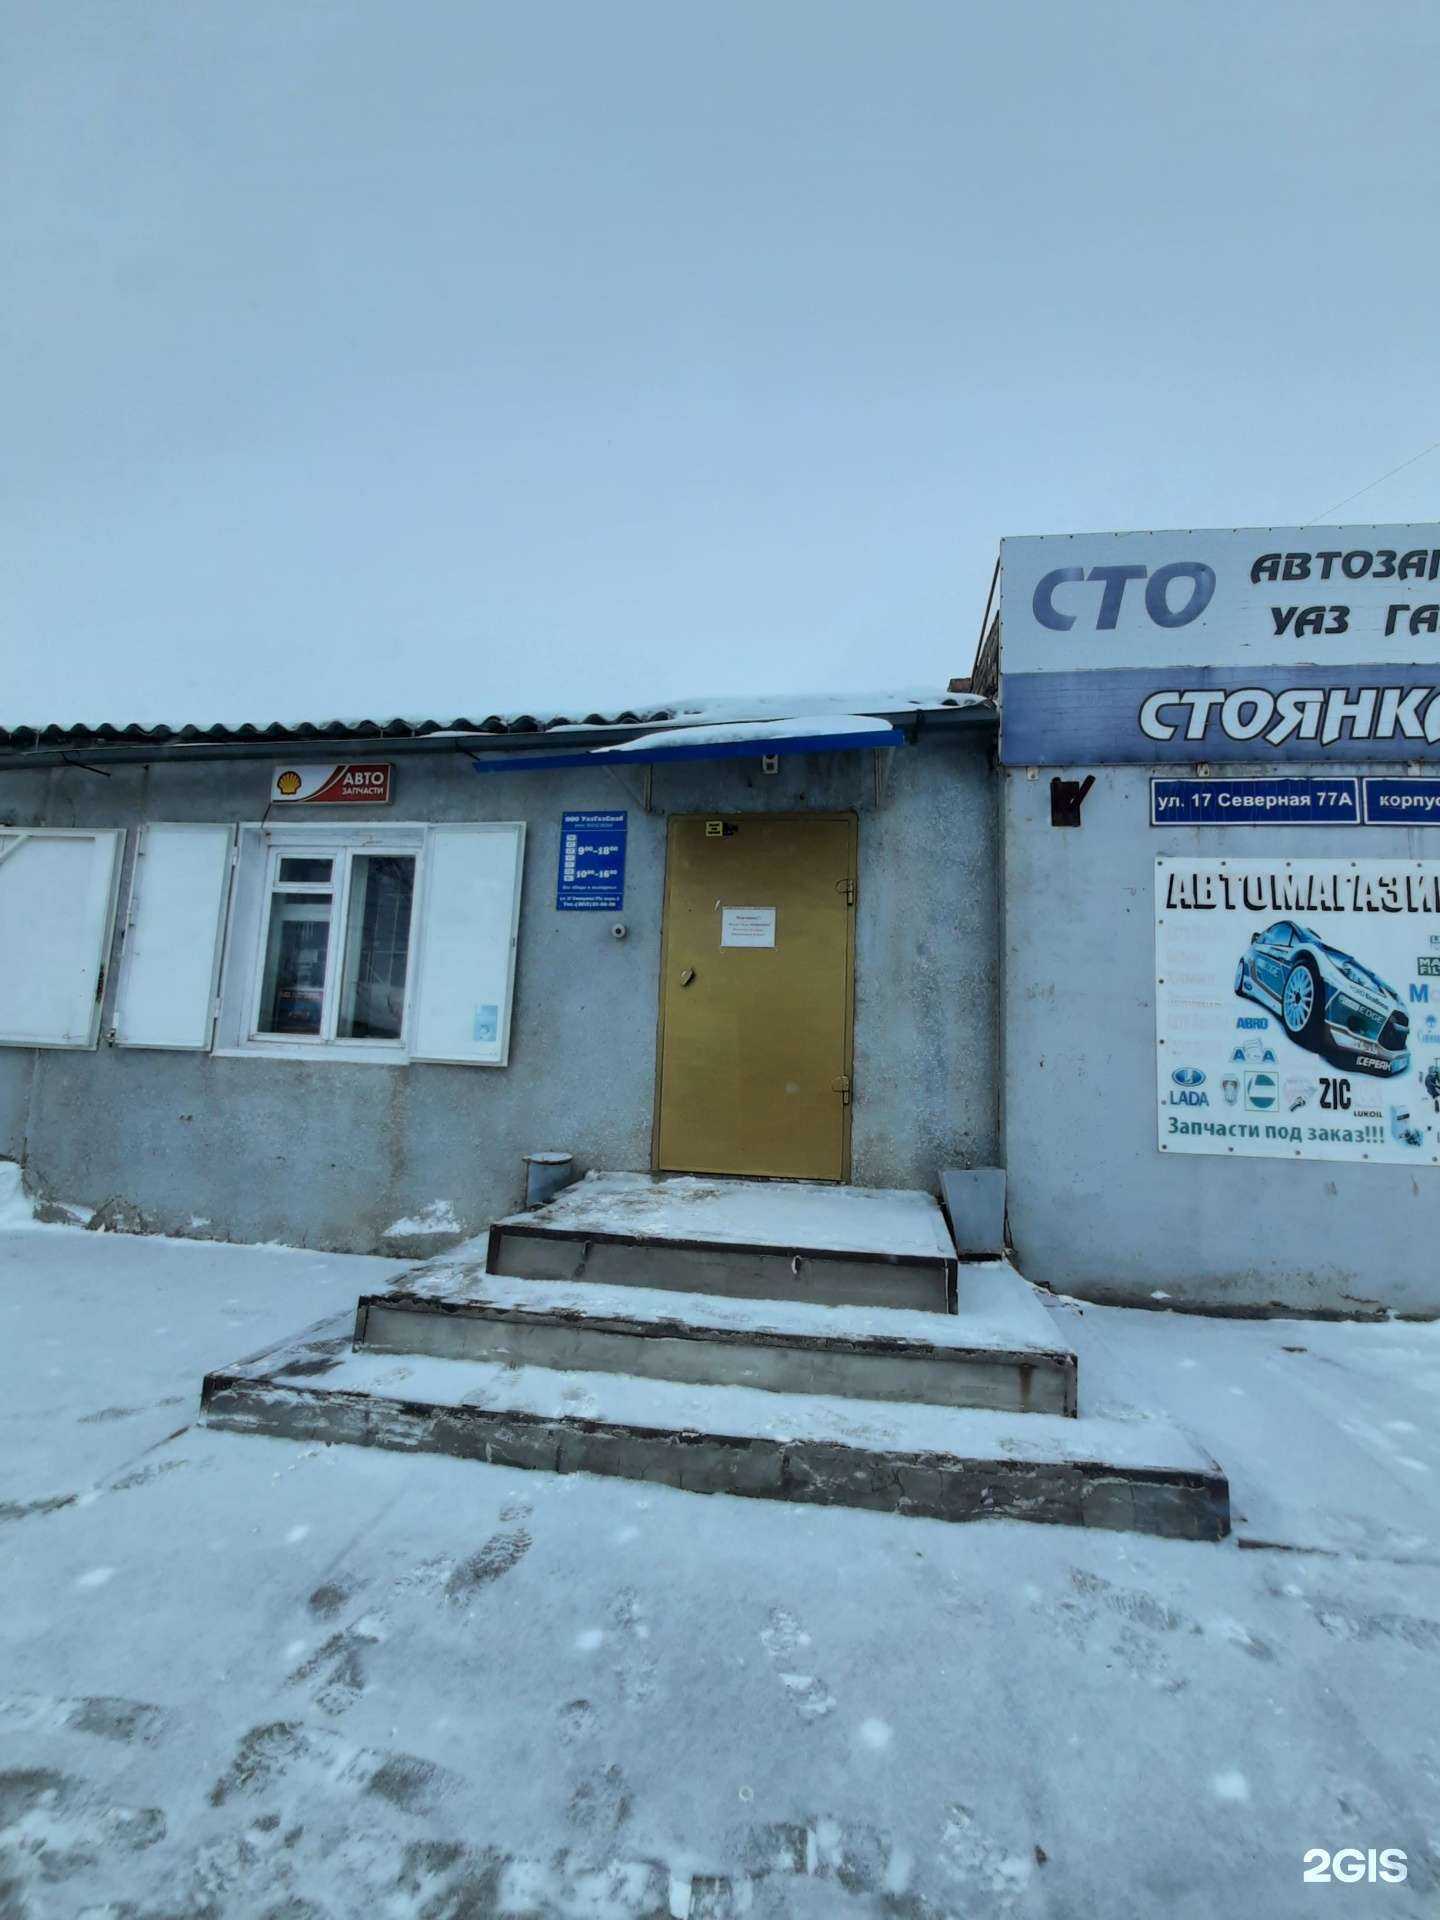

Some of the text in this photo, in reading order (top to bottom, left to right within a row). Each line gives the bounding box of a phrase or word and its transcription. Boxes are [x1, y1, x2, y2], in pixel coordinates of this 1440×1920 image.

[1032, 561, 1217, 631] СТО
[1271, 604, 1440, 638] УАЗ ГА
[343, 772, 384, 786] АВТО
[342, 787, 384, 795] ЗАПЧАСТИ
[1158, 792, 1352, 810] ул. 17 Северная 77А
[1236, 1017, 1268, 1030] ABRO
[1170, 1090, 1209, 1107] LADA
[1319, 1077, 1351, 1110] ZIC
[1353, 1110, 1383, 1119] LUKOIL
[1168, 1116, 1384, 1143] Запчасти под заказ!!!
